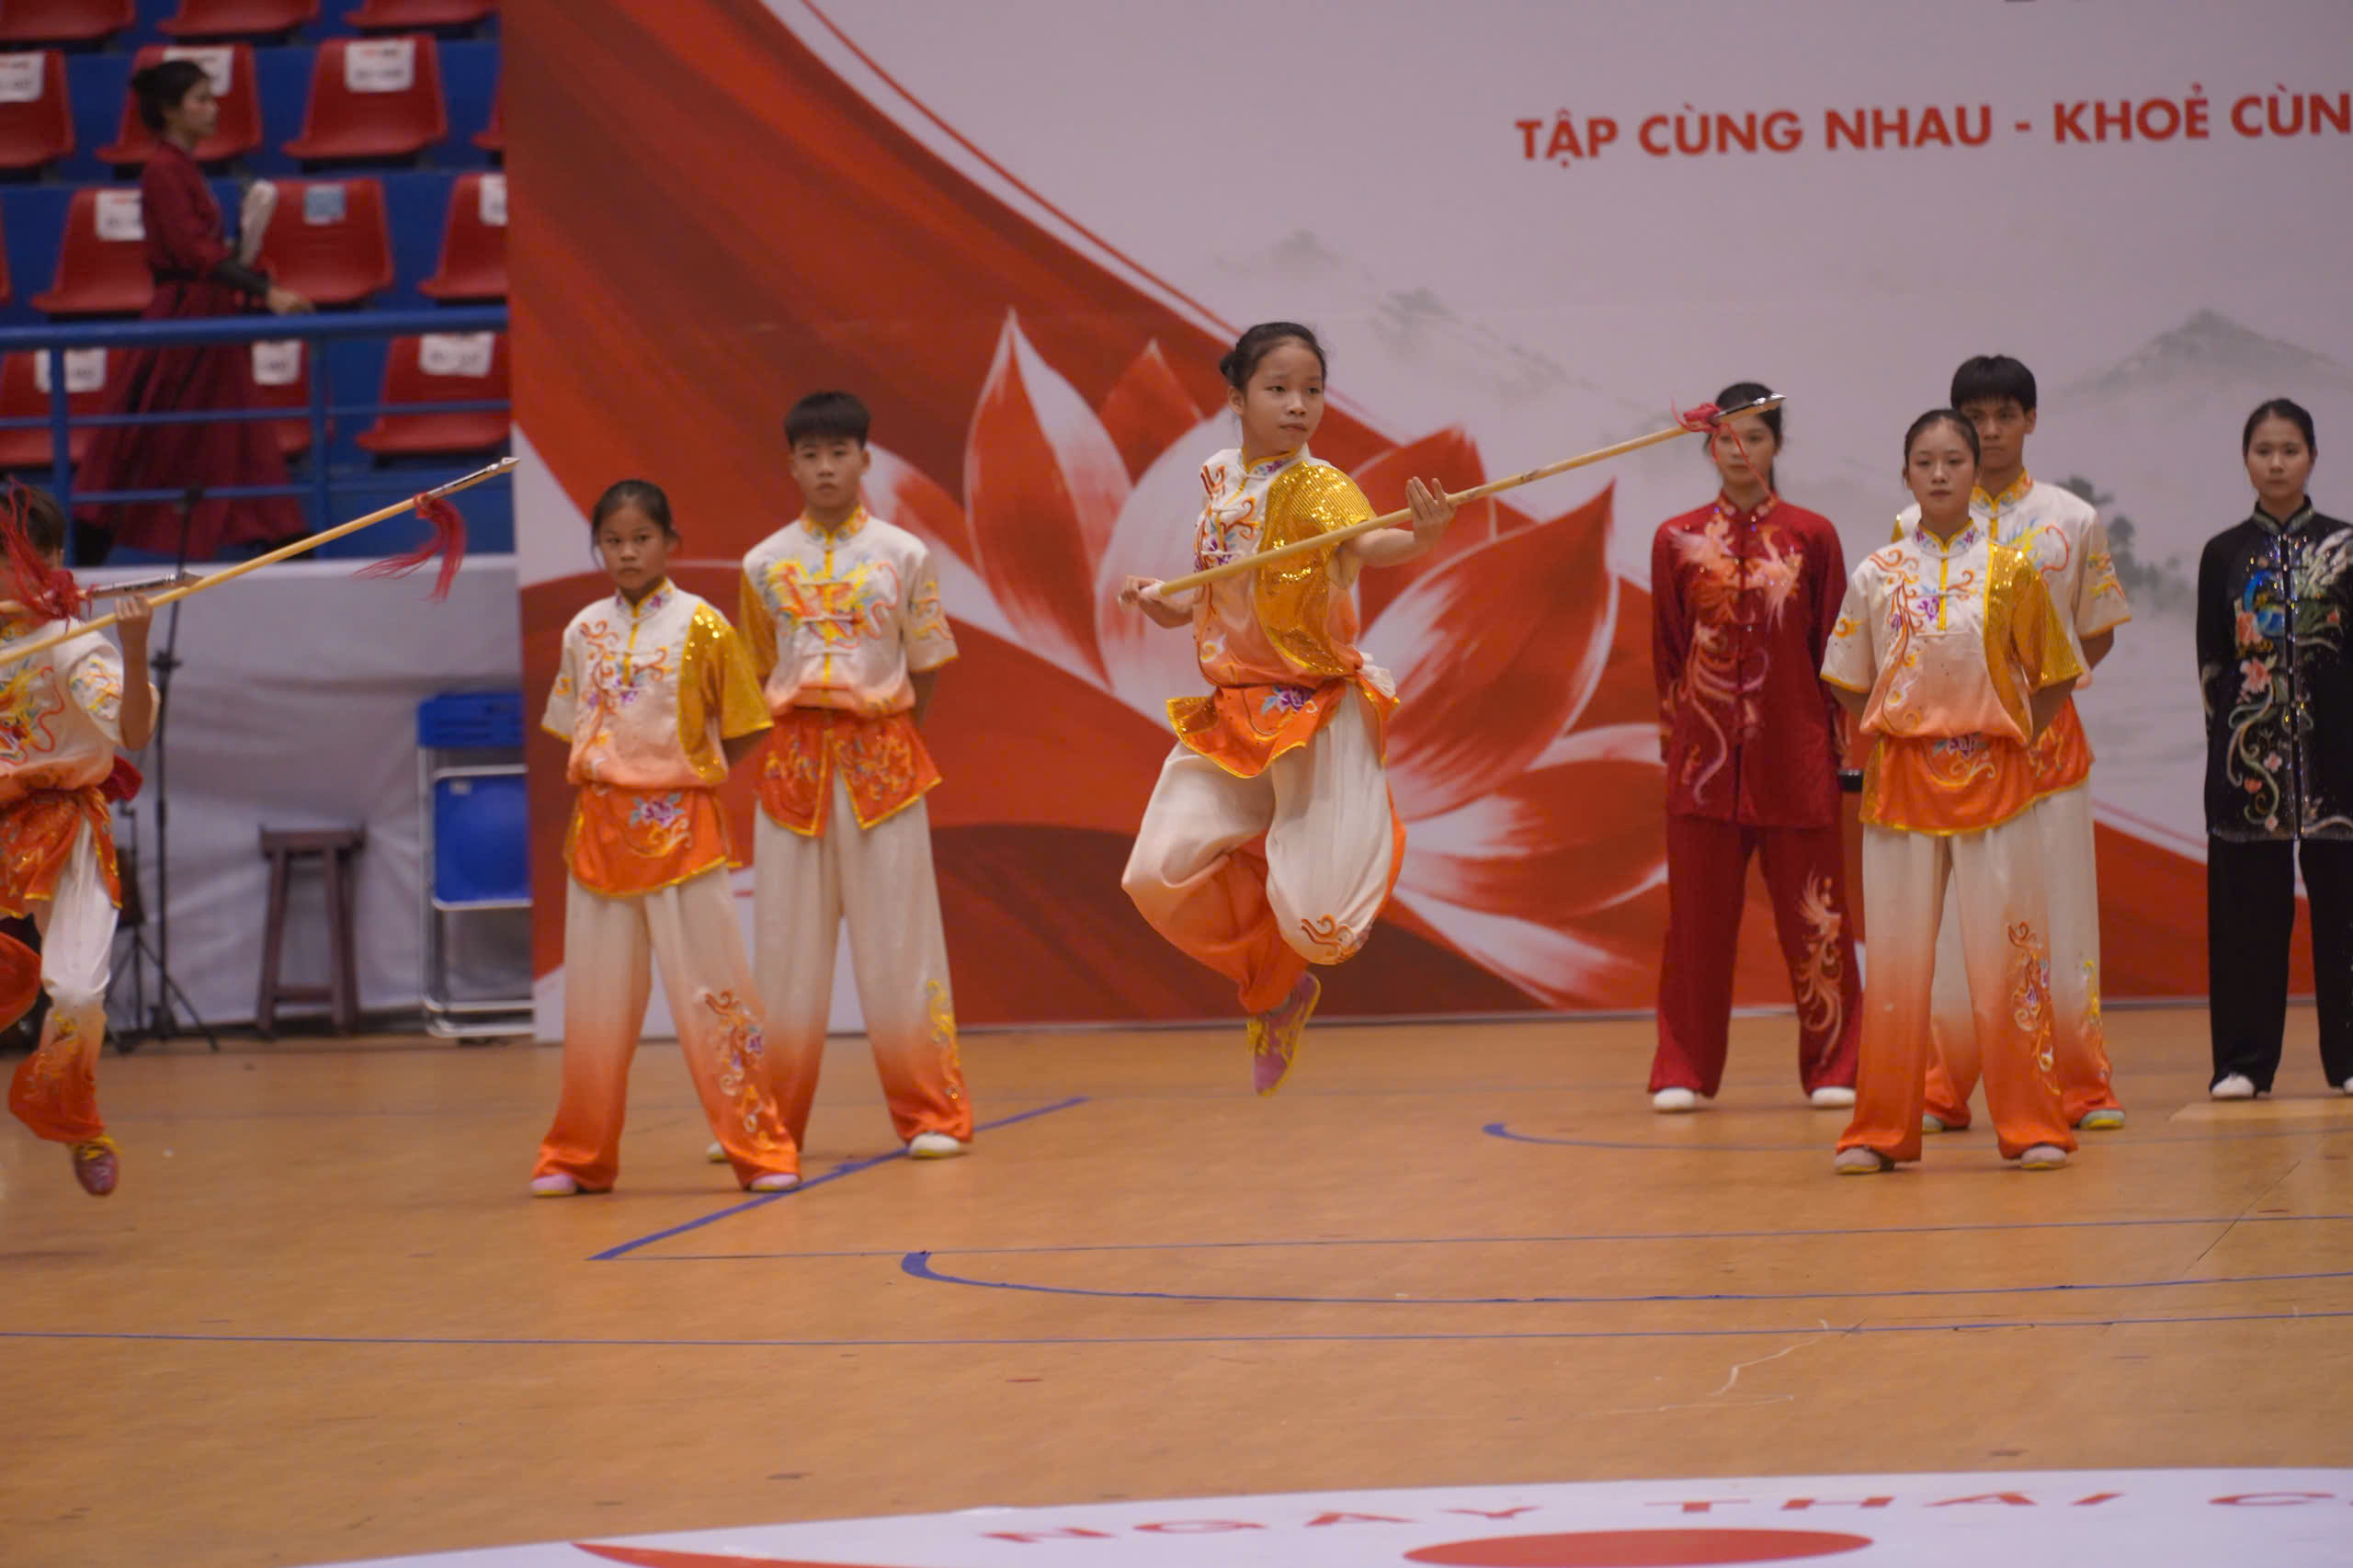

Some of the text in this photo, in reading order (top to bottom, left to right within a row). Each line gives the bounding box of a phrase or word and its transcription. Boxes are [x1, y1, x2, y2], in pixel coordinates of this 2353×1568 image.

[1514, 108, 1619, 169] TẬP
[1638, 103, 1803, 157] CÙNG
[1824, 103, 1993, 150] NHAU
[2014, 120, 2029, 132] -
[2052, 83, 2210, 143] KHOẺ
[2209, 1491, 2353, 1506] C
